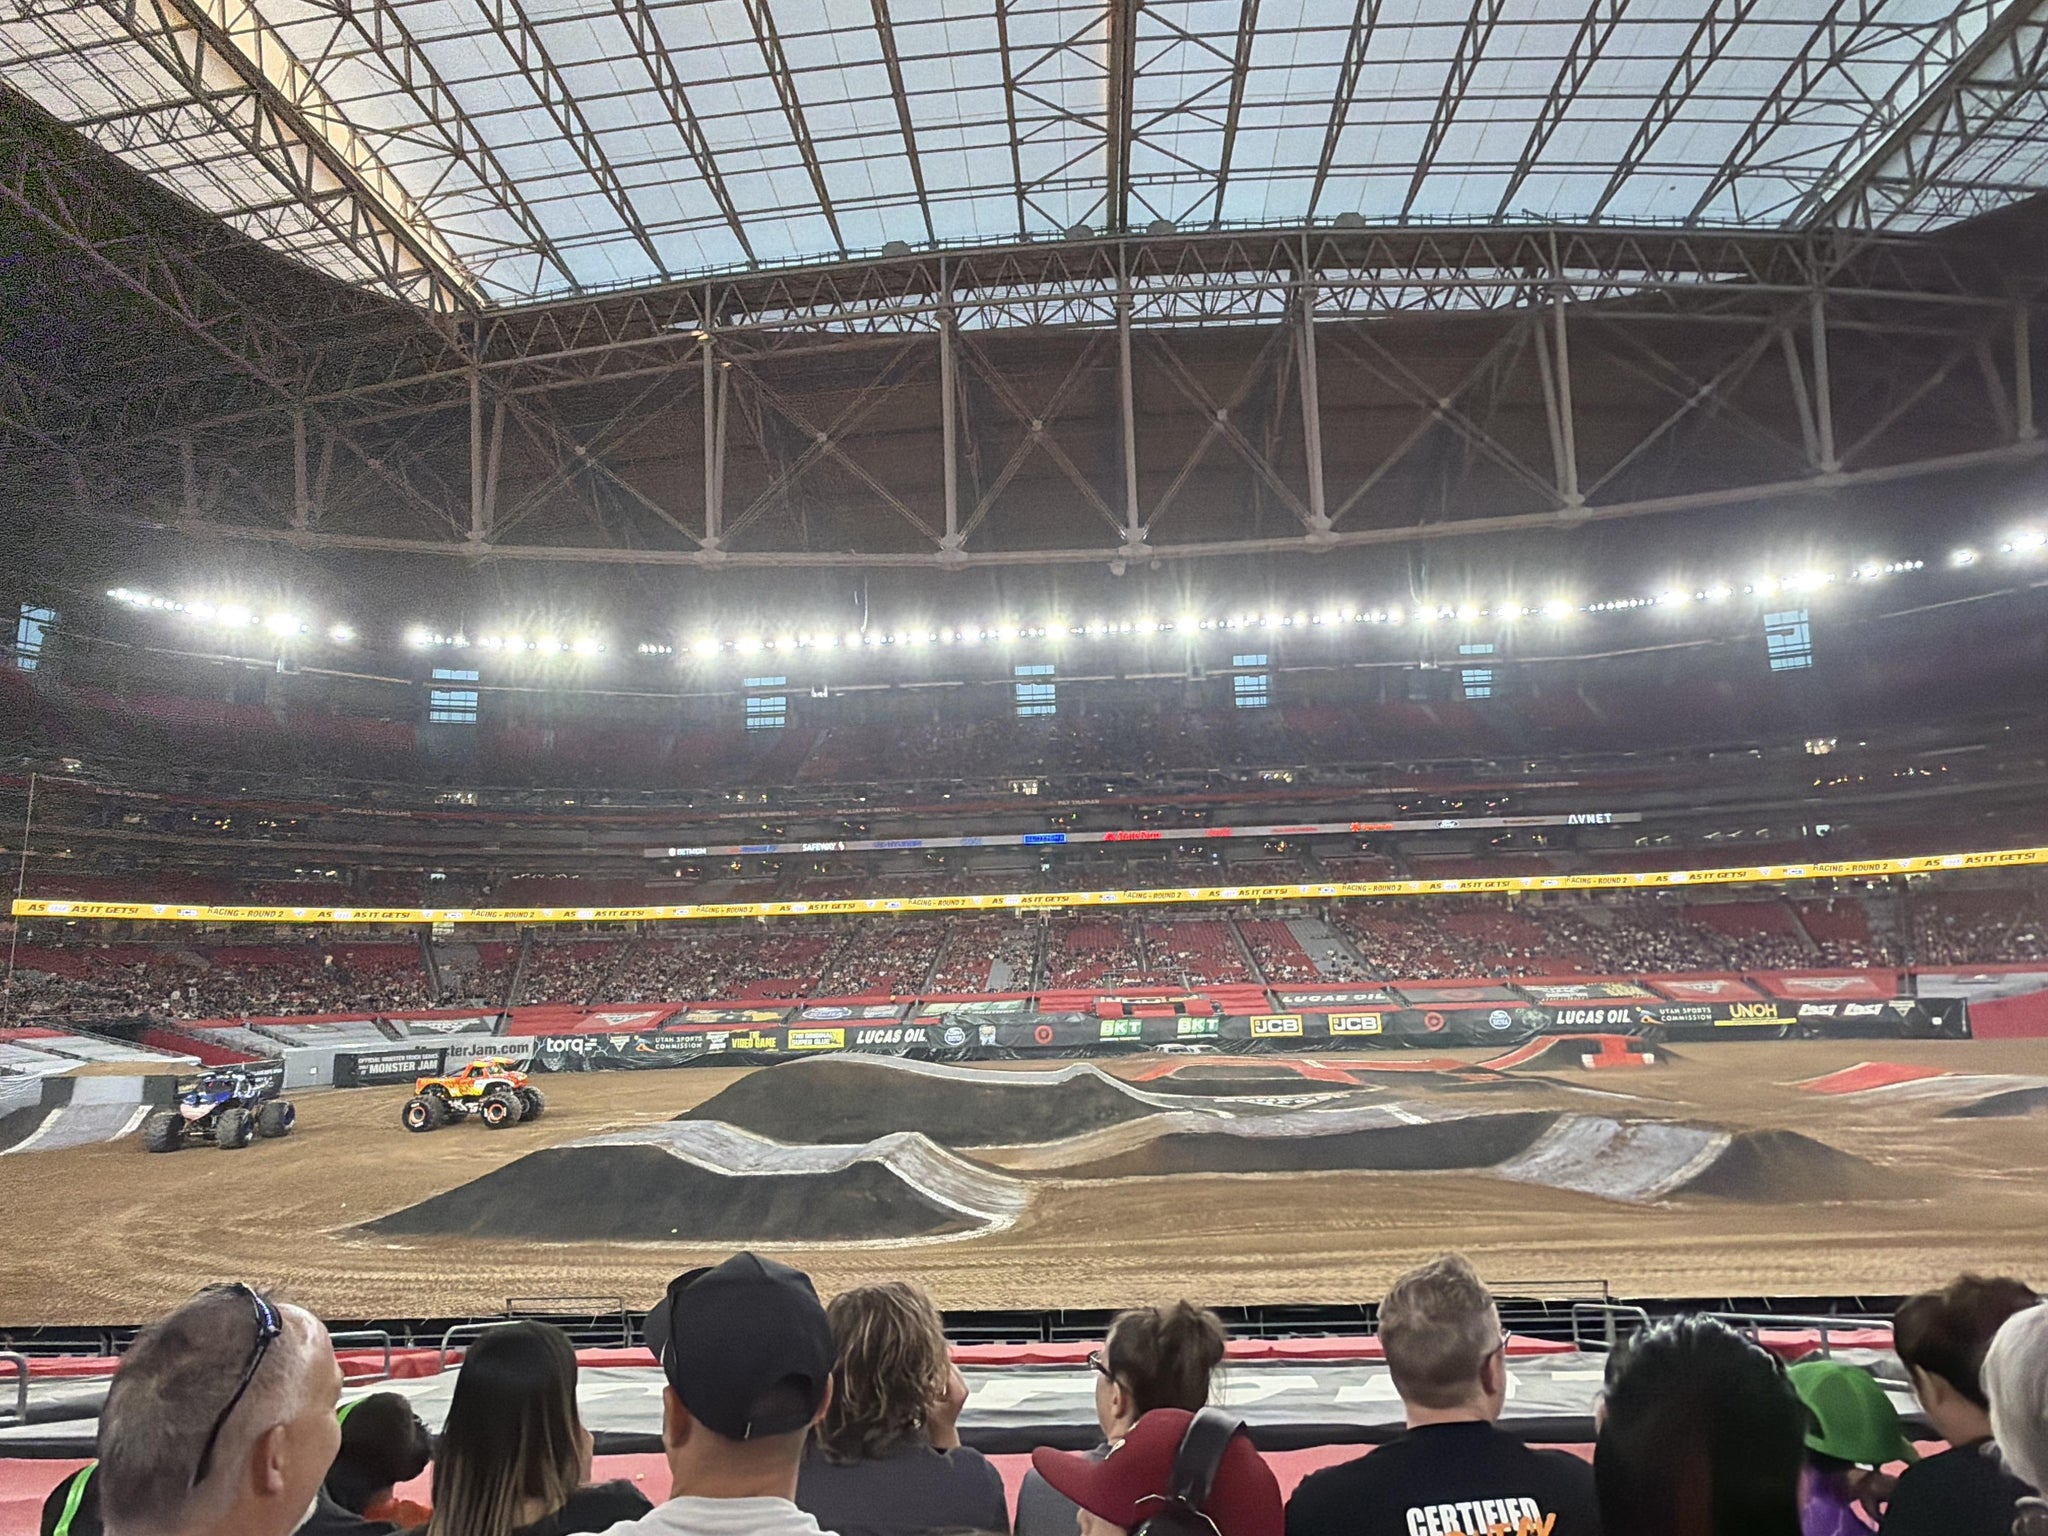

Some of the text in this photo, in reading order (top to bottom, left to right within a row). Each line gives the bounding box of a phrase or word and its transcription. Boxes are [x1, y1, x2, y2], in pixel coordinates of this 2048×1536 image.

[802, 842, 837, 852] SAFEWAY
[1812, 863, 1844, 872] RACING
[1852, 864, 1879, 872] ROUND
[1598, 877, 1621, 885] ROUND
[1154, 892, 1177, 900] ROUND
[207, 906, 241, 917] RACING
[1282, 992, 1387, 1003] LUCAS OIL
[1556, 1009, 1633, 1024] LUCAS OIL
[1729, 1003, 1777, 1018] UNOH
[1334, 1017, 1377, 1031] JCB
[1660, 1014, 1712, 1022] COMMISSION
[1100, 1020, 1142, 1036] BKT
[1177, 1017, 1219, 1033] BKT
[1254, 1019, 1299, 1033] JCB
[856, 1029, 902, 1044] LUCAS
[904, 1028, 928, 1043] OIL
[732, 1038, 754, 1049] VIDEO
[755, 1038, 777, 1048] GAME
[370, 1060, 438, 1074] MONSTER JAM
